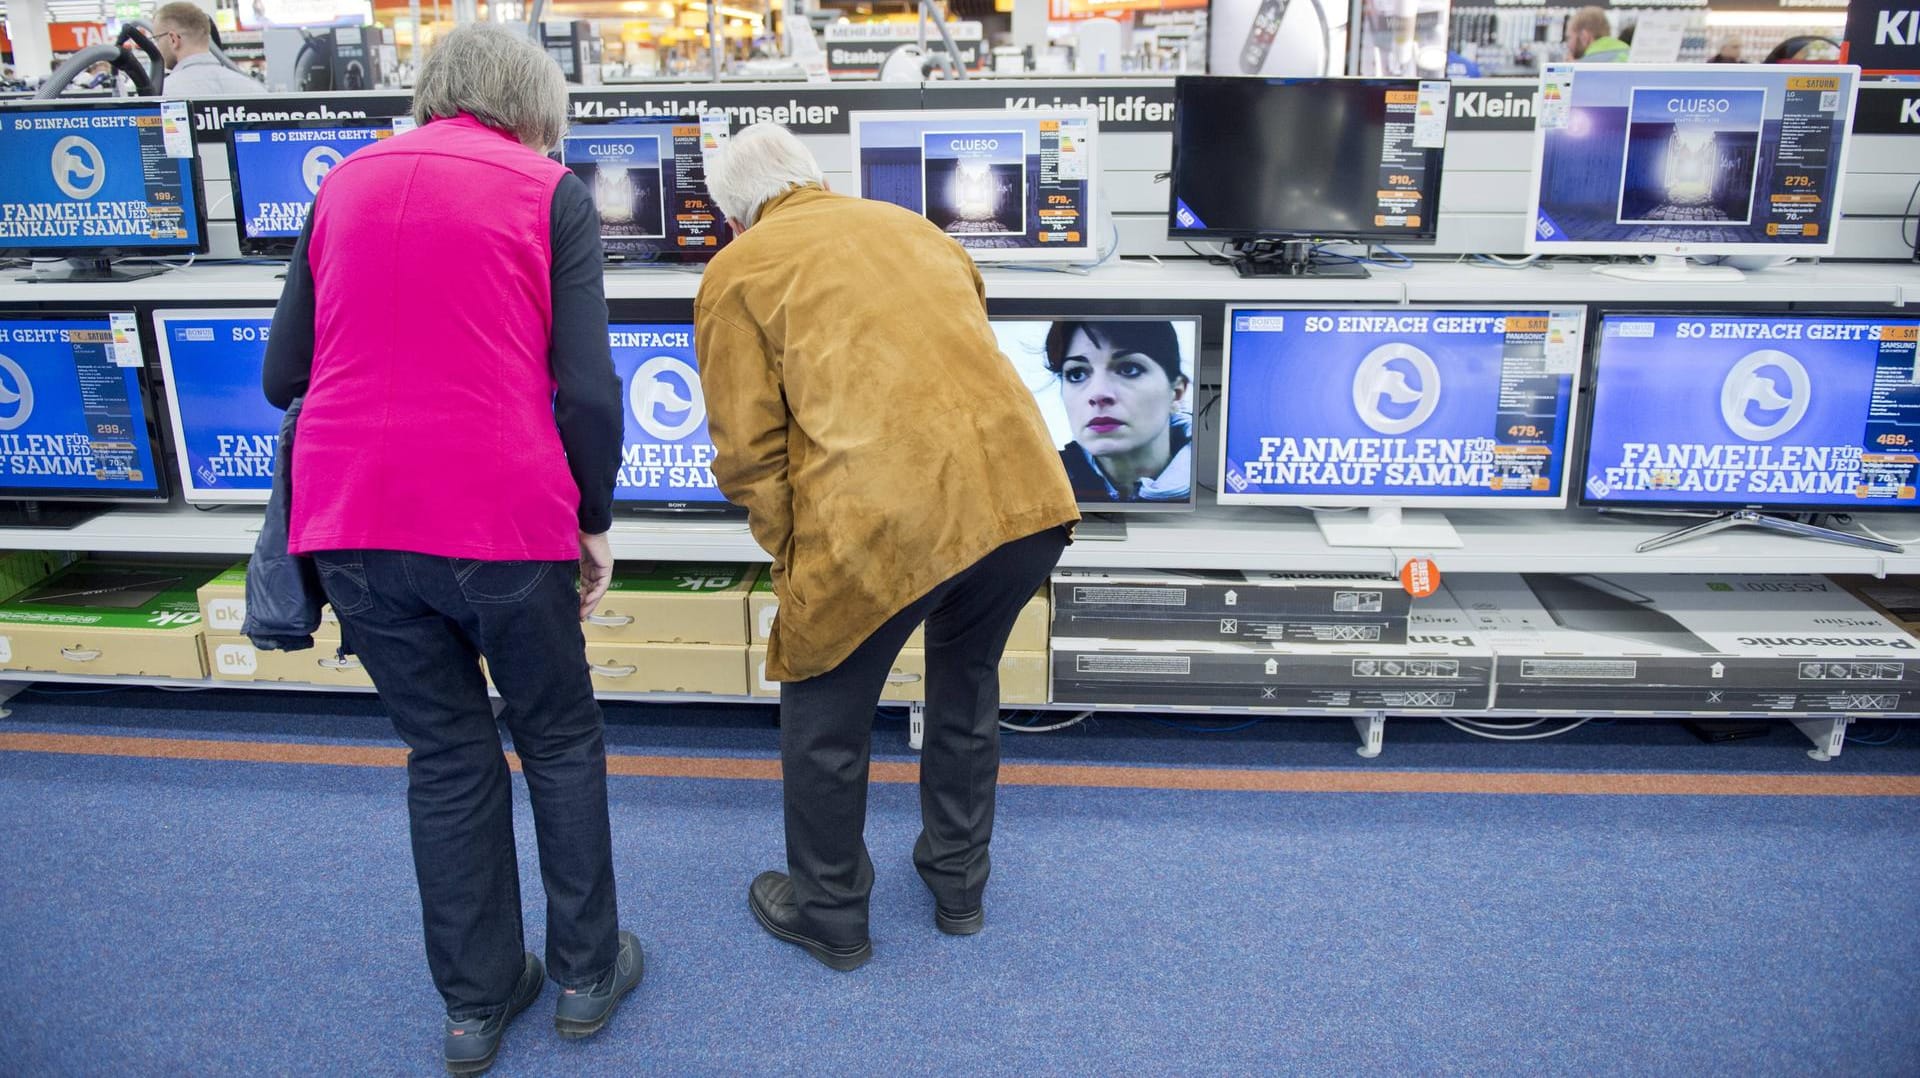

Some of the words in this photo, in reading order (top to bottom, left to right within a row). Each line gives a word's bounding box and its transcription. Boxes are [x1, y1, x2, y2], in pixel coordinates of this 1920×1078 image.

[1875, 10, 1920, 45] Kl
[1806, 79, 1835, 89] SATURN
[1667, 99, 1730, 113] CLUESO
[15, 119, 32, 130] SO
[34, 117, 89, 130] EINFACH
[91, 115, 138, 128] GEHT'S
[271, 132, 287, 142] SO
[289, 131, 337, 142] EINFACH
[338, 129, 377, 140] GEHT'S
[588, 144, 635, 155] CLUESO
[950, 139, 999, 151] CLUESO
[1784, 176, 1816, 187] 279,-
[3, 202, 127, 221] FANMEILEN
[128, 200, 147, 209] FÜR
[1177, 208, 1195, 225] LED
[0, 219, 80, 237] EINKAUF
[1537, 216, 1555, 237] LED
[1305, 316, 1334, 333] SO
[1337, 316, 1428, 333] EINFACH
[1432, 316, 1506, 333] GEHT'S
[1676, 322, 1705, 339] SO
[1709, 322, 1802, 340] EINFACH
[1806, 324, 1882, 341] GEHT'S
[12, 329, 71, 343] GEHT'S
[232, 327, 255, 341] SO
[609, 332, 689, 348] EINFACH
[1880, 341, 1916, 350] SAMSUNG
[96, 424, 126, 435] 299,-
[0, 434, 66, 456] ILEN
[64, 432, 91, 445] FÜR
[217, 435, 280, 457] FAN
[1258, 437, 1464, 463] FANMEILEN
[1464, 436, 1496, 451] FÜR
[621, 444, 719, 468] MEILE
[1620, 443, 1831, 472] FANMEILEN
[1831, 444, 1864, 459] FÜR
[198, 465, 217, 485] LED
[1226, 468, 1249, 491] LED
[1244, 462, 1383, 485] EINKAUF
[1586, 474, 1611, 499] LED
[673, 576, 733, 591] ok.
[1410, 562, 1420, 592] SELLER
[1418, 561, 1430, 592] BEST
[1747, 581, 1829, 592] AS500
[148, 611, 202, 626] ok.
[215, 606, 244, 621] ok.
[1736, 637, 1916, 650] Panasonic
[223, 651, 253, 667] ok.
